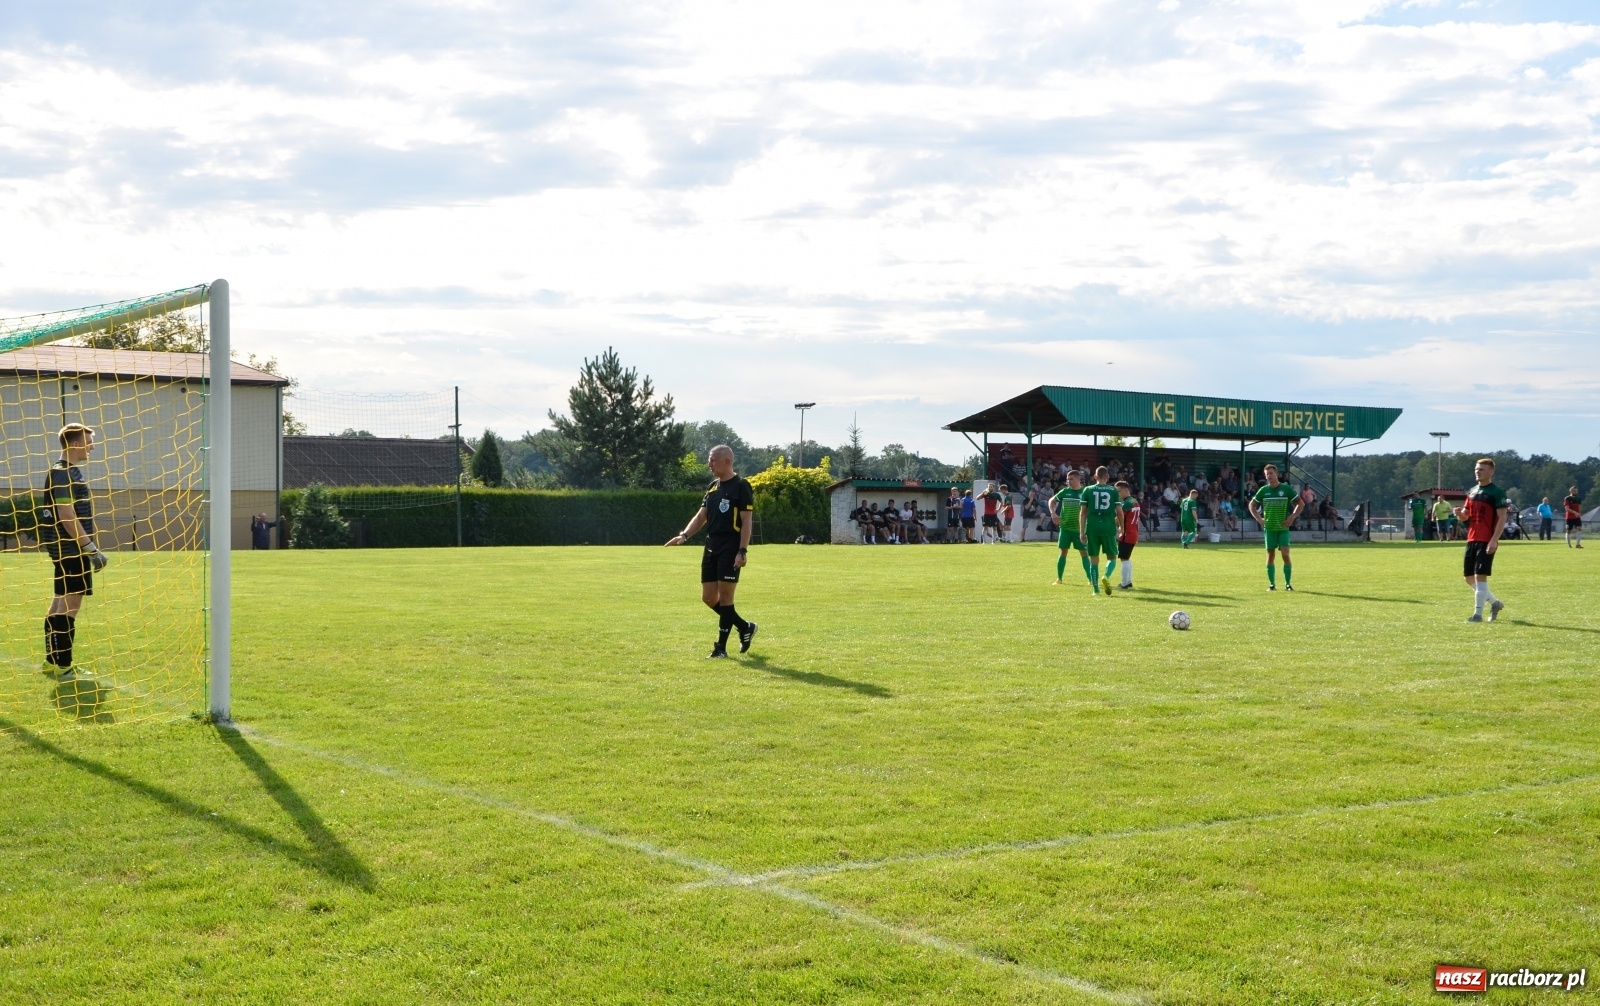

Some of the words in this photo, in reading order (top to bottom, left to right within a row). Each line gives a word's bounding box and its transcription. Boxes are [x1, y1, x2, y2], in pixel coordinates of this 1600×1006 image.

[1152, 402, 1175, 422] KS
[1193, 405, 1254, 427] CZARNI
[1272, 409, 1345, 431] GORZYCE
[1092, 491, 1111, 510] 13
